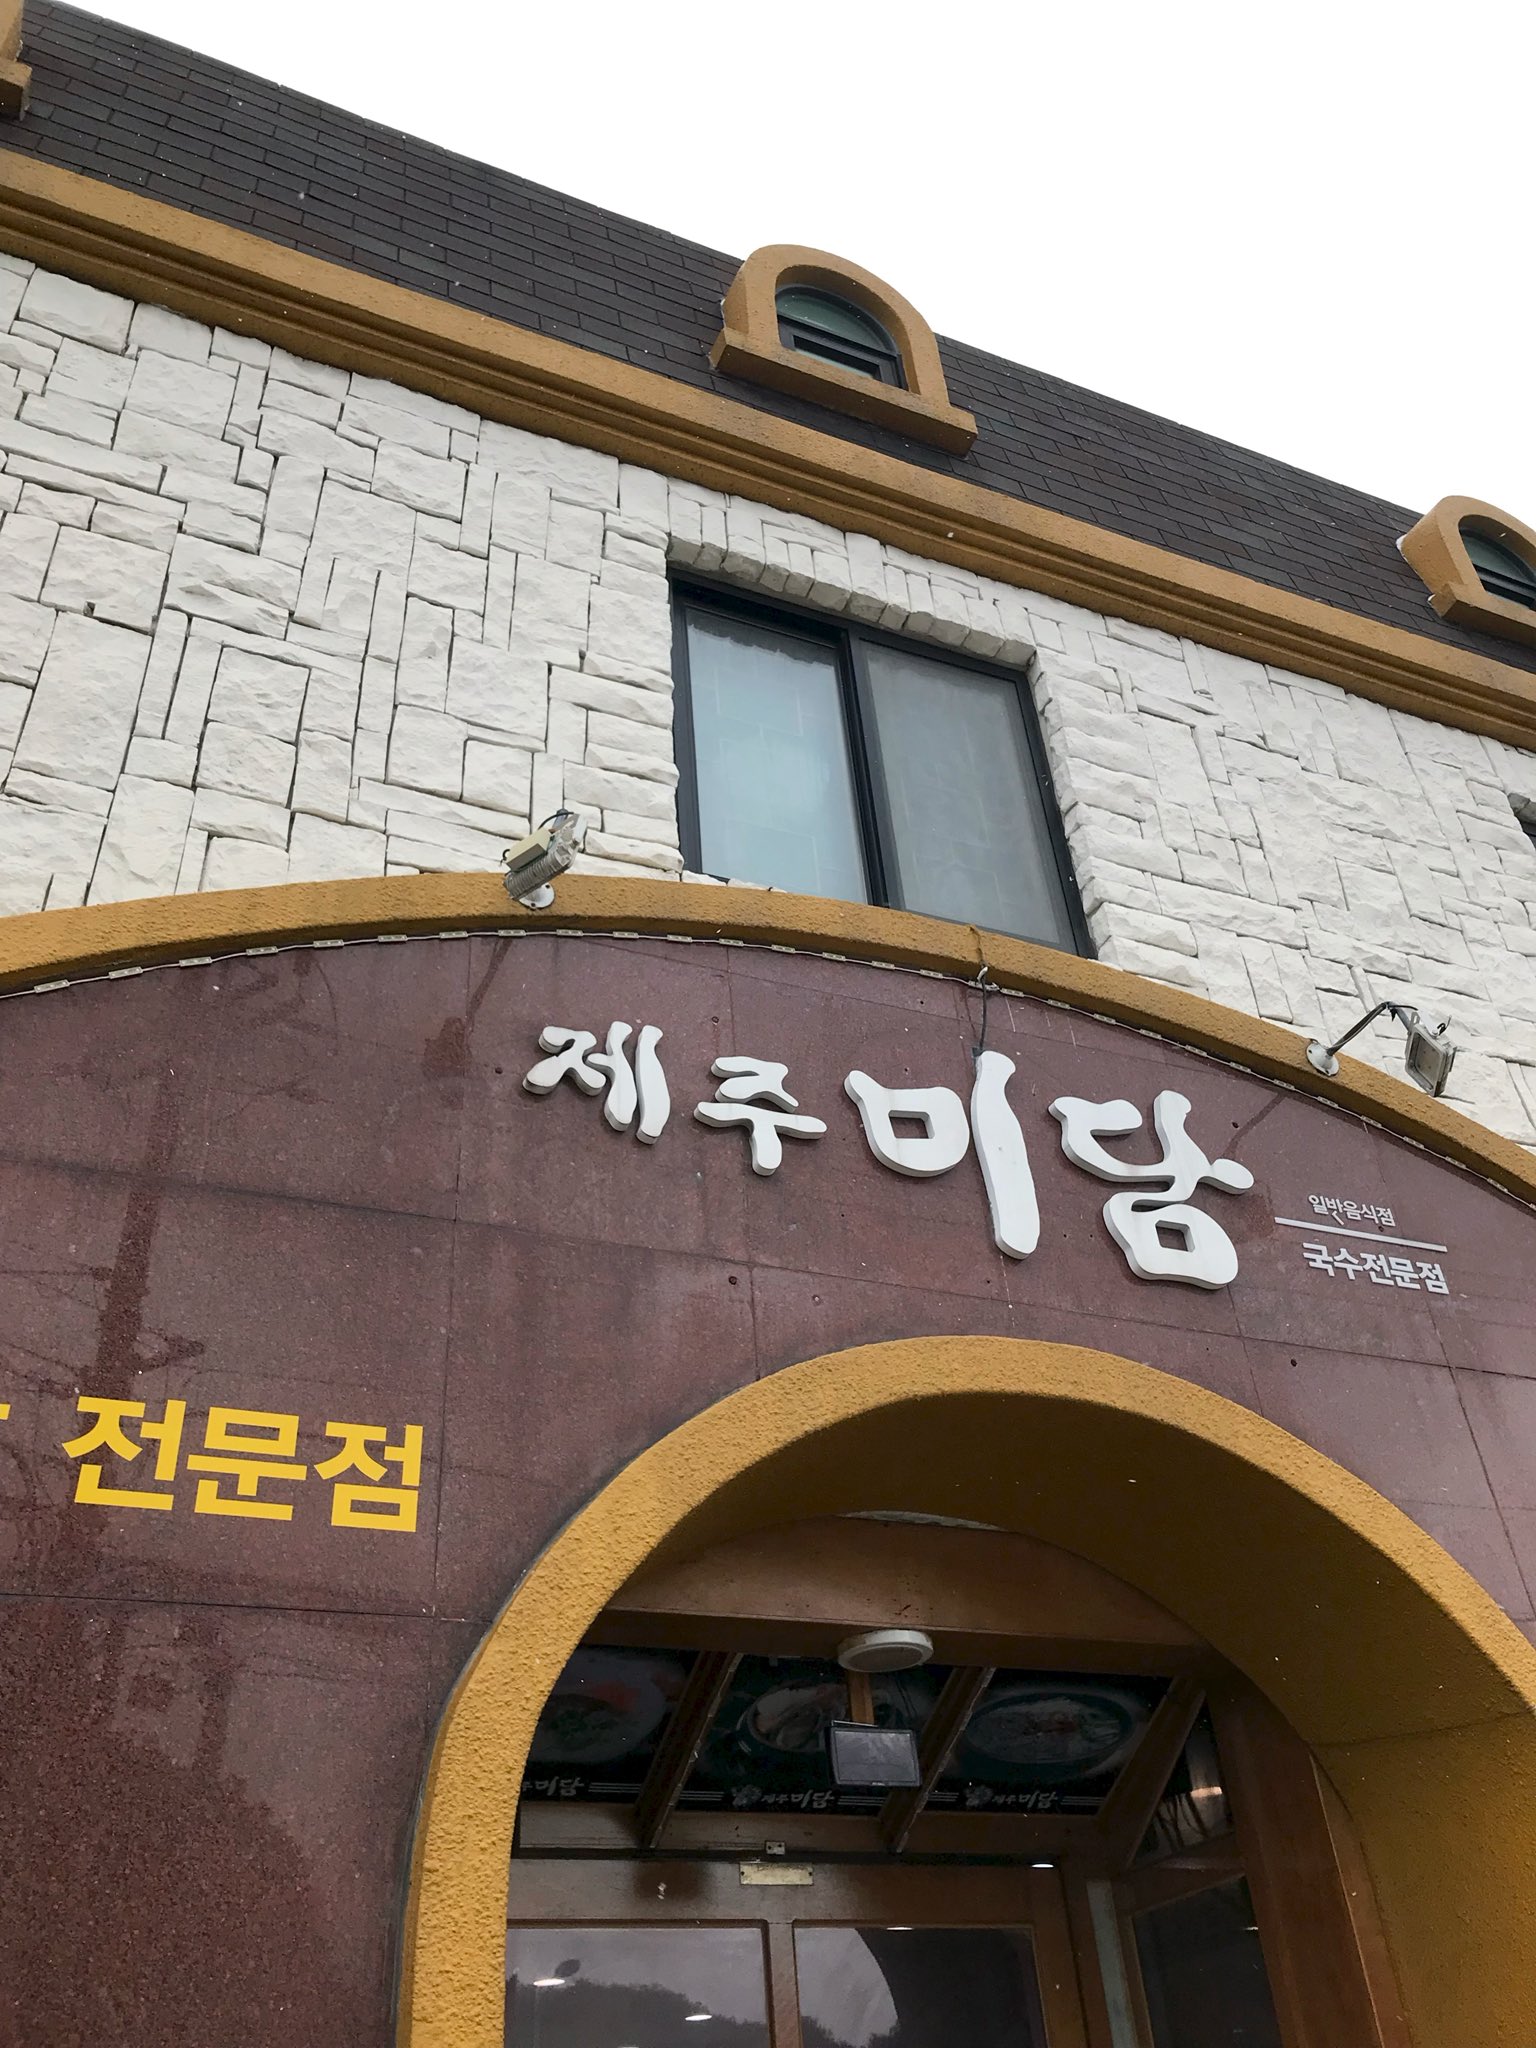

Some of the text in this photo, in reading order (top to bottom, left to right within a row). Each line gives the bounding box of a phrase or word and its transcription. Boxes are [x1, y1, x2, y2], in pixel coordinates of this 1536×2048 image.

[1308, 1194, 1397, 1227] 일반음식점
[1302, 1242, 1450, 1295] 국수전문점
[61, 1396, 424, 1533] 전문점
